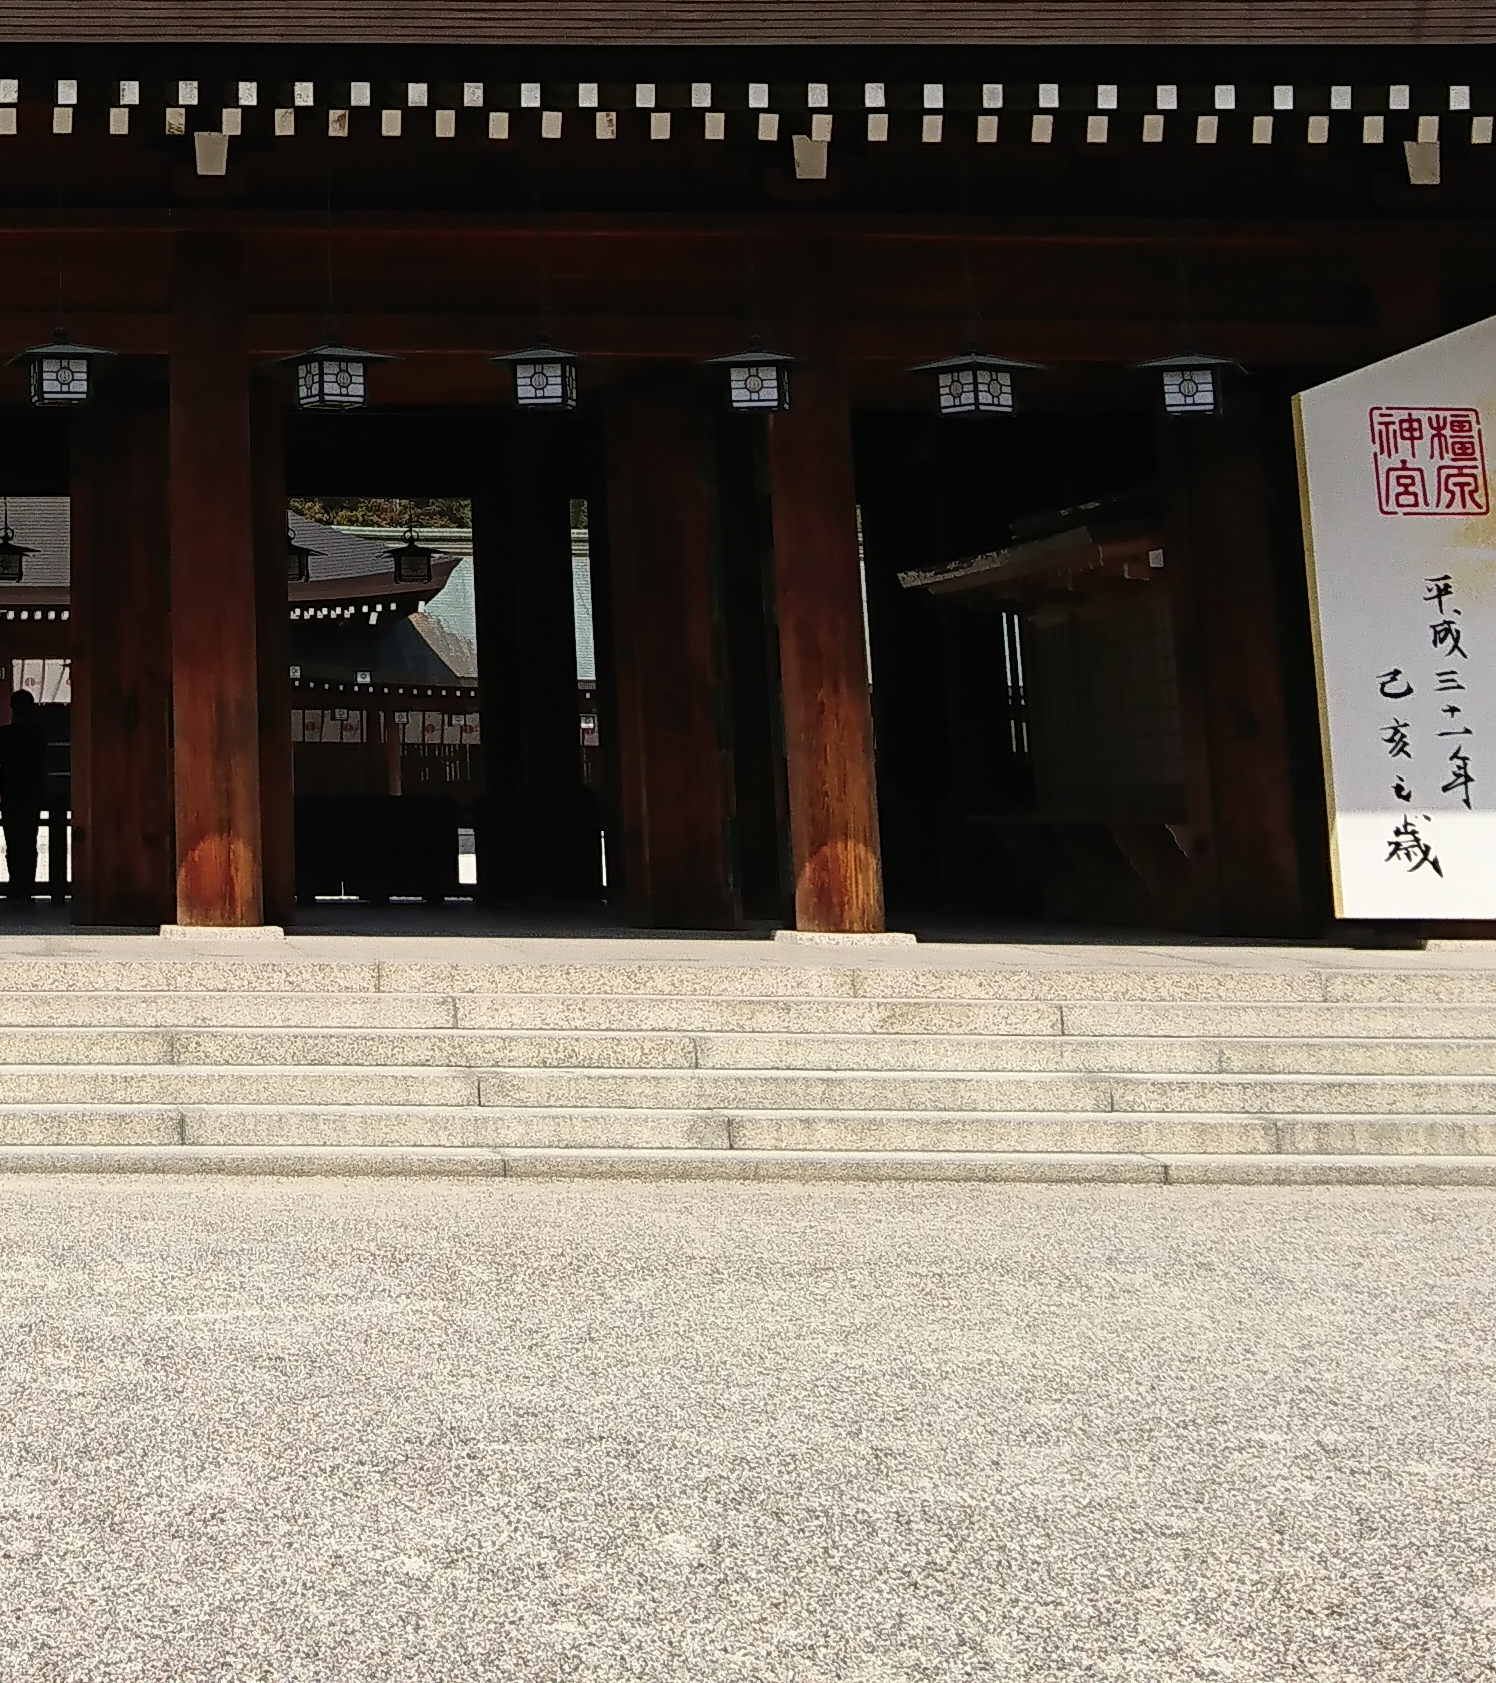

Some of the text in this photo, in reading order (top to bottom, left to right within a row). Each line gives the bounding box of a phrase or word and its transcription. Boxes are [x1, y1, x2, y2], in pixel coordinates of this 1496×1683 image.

[1376, 411, 1430, 509] 神宮
[1422, 574, 1476, 810] 平成三十一年
